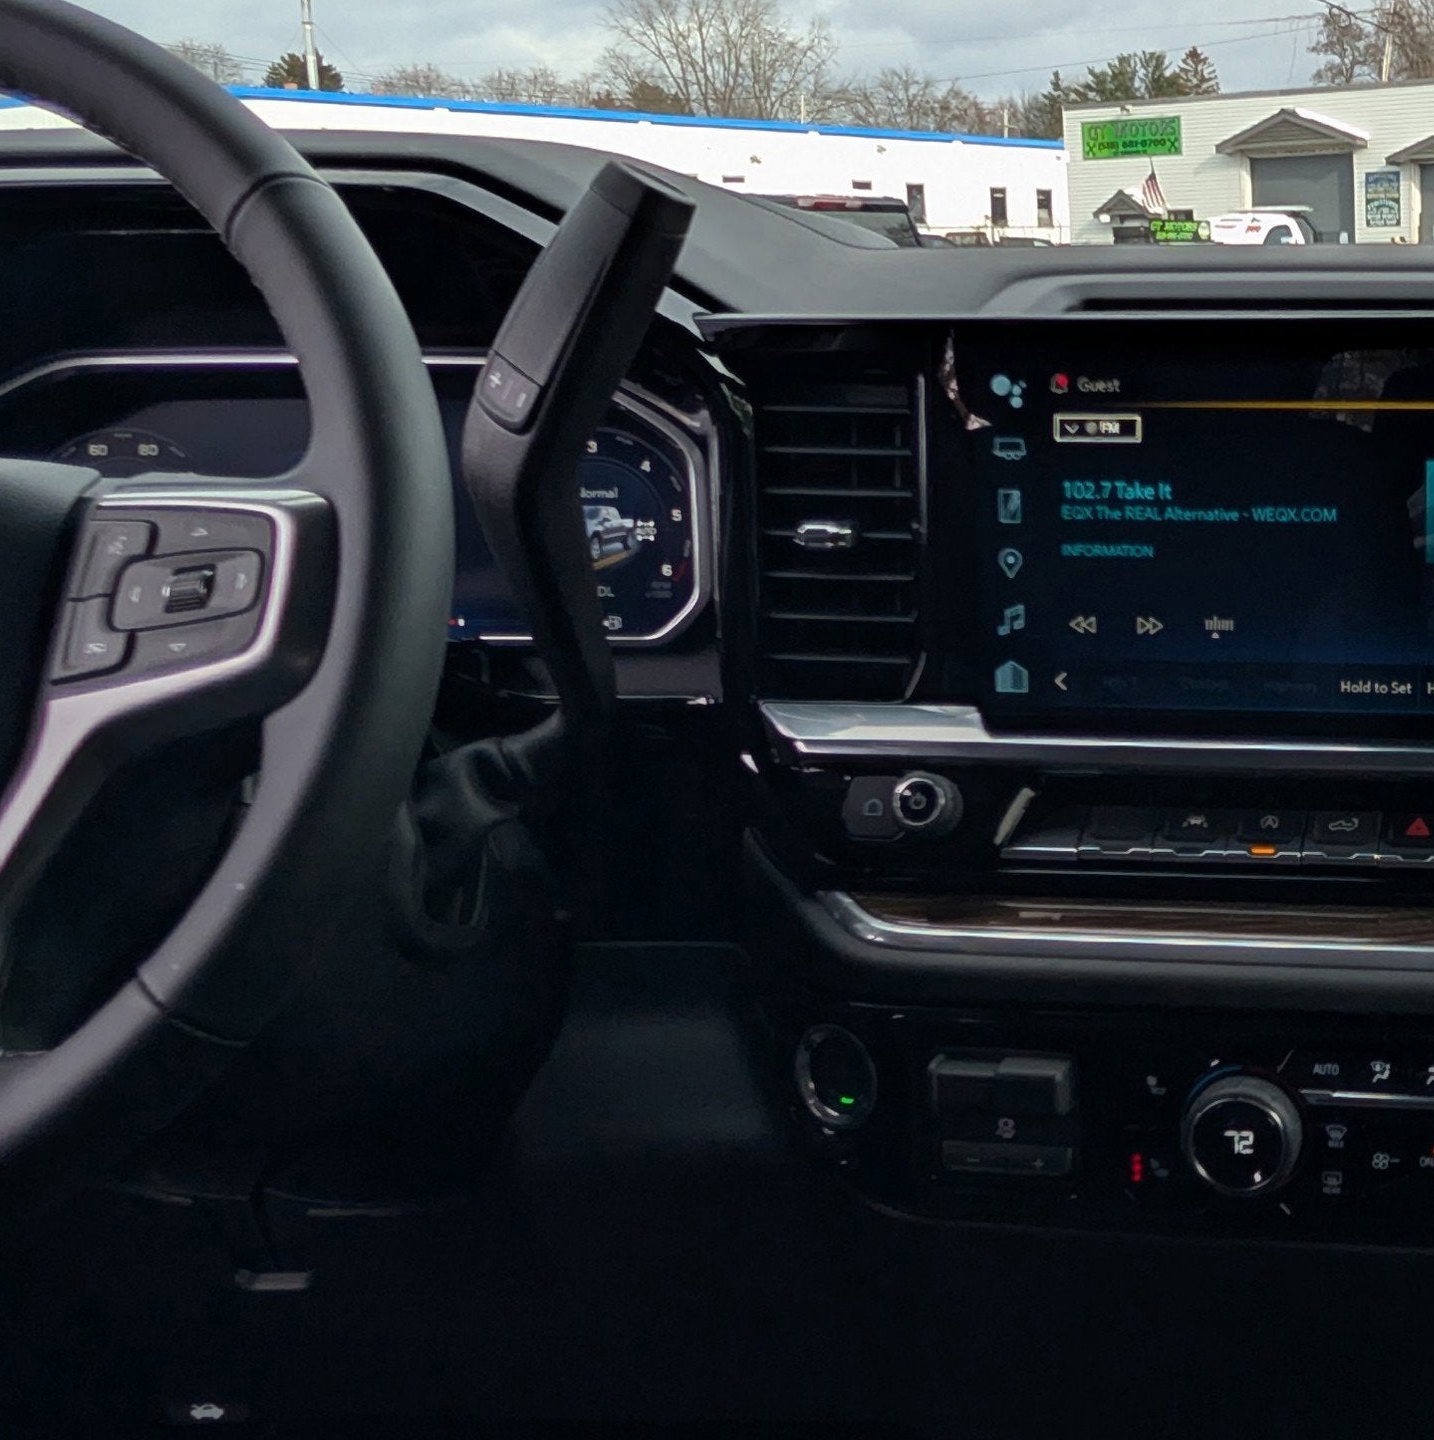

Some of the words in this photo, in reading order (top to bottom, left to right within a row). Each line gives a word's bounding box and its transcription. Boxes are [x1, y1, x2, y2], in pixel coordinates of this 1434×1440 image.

[1077, 377, 1121, 393] Guest
[1099, 421, 1121, 435] FM
[87, 444, 109, 457] 60
[1063, 480, 1112, 500] 102.7
[1115, 480, 1156, 500] Take
[1158, 482, 1173, 500] It
[671, 508, 683, 522] 5
[1095, 506, 1123, 521] The
[1125, 506, 1163, 521] REAL
[1165, 506, 1240, 522] Alternative
[1061, 543, 1154, 558] INFORMATION
[661, 563, 673, 577] 6
[1340, 680, 1371, 695] Hold
[1374, 682, 1388, 695] to
[1391, 681, 1412, 695] Set
[1313, 1063, 1340, 1076] AUTO
[1223, 1130, 1255, 1155] 72
